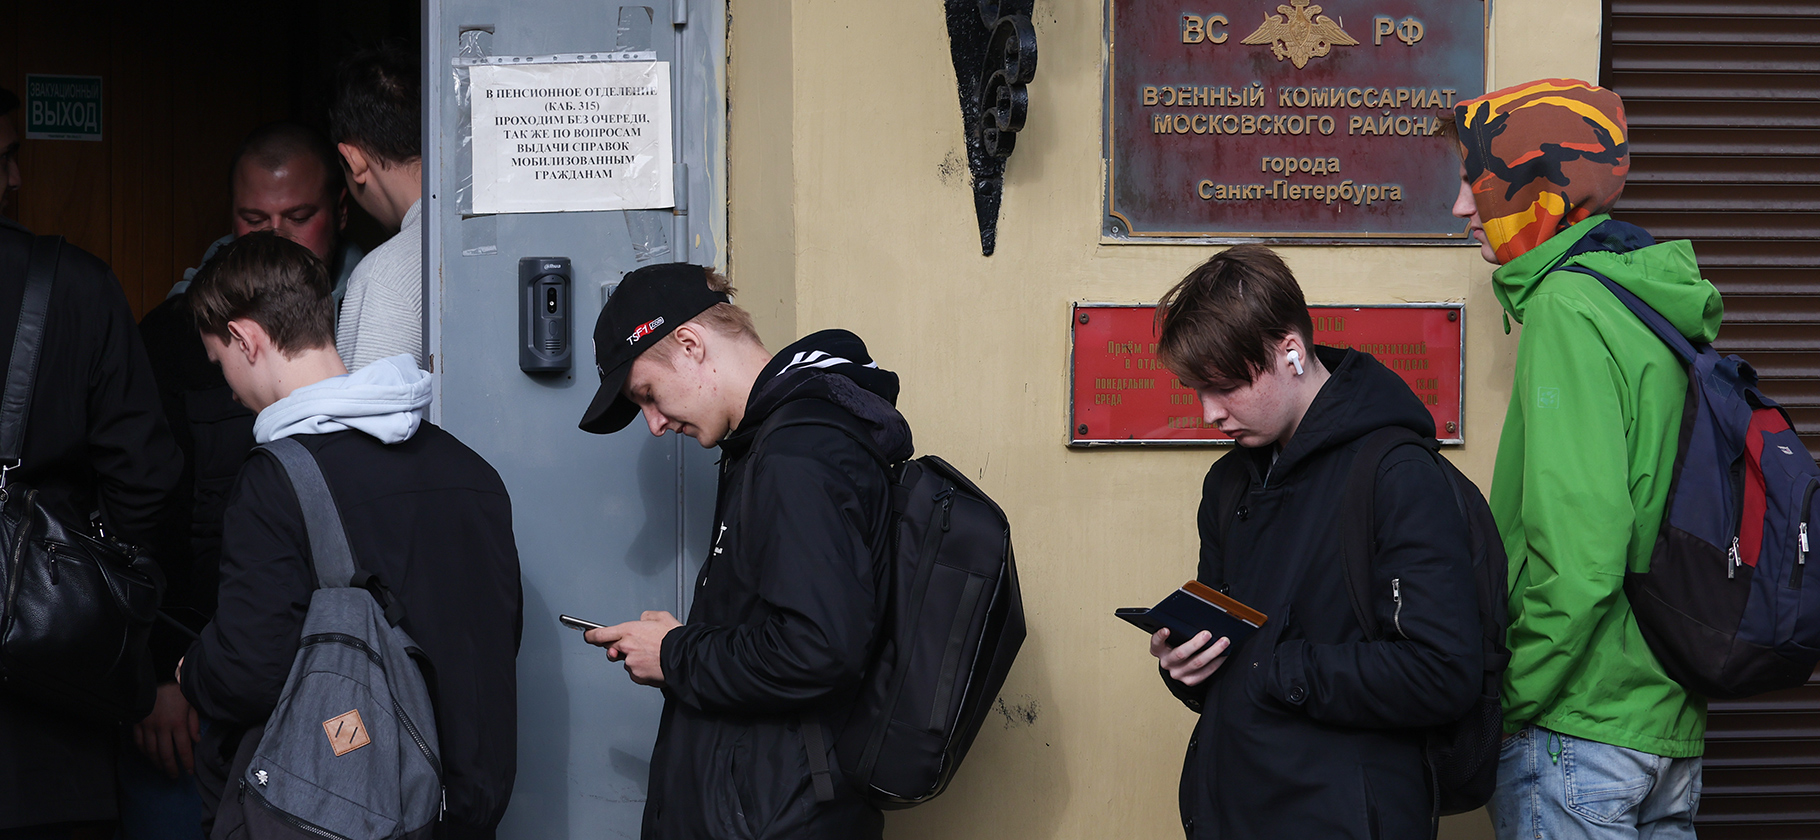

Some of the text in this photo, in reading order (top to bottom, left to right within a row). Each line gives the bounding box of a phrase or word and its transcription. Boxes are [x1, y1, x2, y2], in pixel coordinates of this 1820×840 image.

[1182, 14, 1425, 46] ВС РФ
[486, 86, 658, 99] В ПЕНСИОННОЕ ОТДЕЛЕНИЕ
[1142, 81, 1456, 109] ВОЕННЫЙ КОМИССАРИАТ
[544, 100, 600, 112] (КАБ. 315)
[32, 100, 98, 132] ВЫХОД
[494, 115, 564, 126] ПРОХОДИМ
[567, 114, 589, 125] БЕЗ
[1153, 113, 1335, 135] МОСКОВСКОГО
[503, 127, 641, 139] ТАК ЖЕ ПО ВОПРОСАМ
[517, 141, 630, 154] ВЫДАЧИ СПРАВОК
[511, 155, 635, 167] МОБИЛИЗОВАННЫМ
[1261, 155, 1340, 177] города
[534, 169, 613, 180] ГРАЖДАНАМ
[1197, 179, 1402, 205] Санкт-Петербурга
[1108, 341, 1142, 356] Приём
[1360, 341, 1427, 354] посетителей
[1393, 359, 1429, 371] отдела
[1095, 378, 1155, 391] ПОНЕДЕЛЬНИК
[1416, 378, 1439, 390] 13.00
[1095, 393, 1193, 406] СРЕДА 10.00
